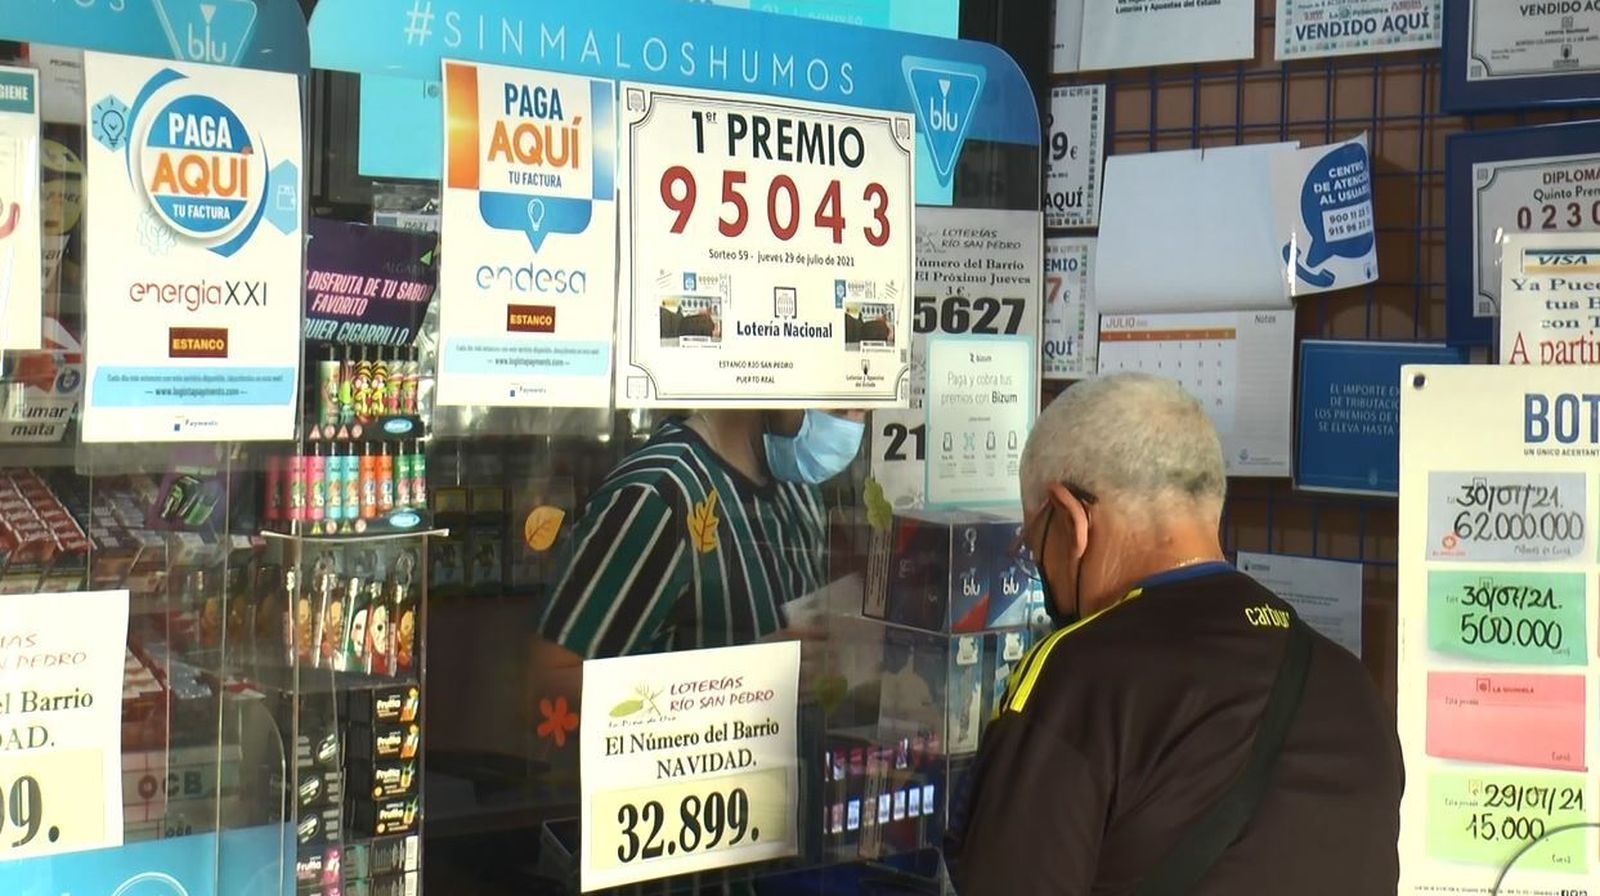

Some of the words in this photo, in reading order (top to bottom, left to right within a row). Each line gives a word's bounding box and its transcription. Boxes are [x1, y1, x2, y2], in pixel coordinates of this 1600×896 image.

[1520, 1, 1581, 16] VENDIDO
[1296, 16, 1377, 41] VENDIDO
[1382, 7, 1430, 34] AQUÍ
[188, 22, 227, 62] blu
[404, 0, 855, 96] #SINMALOSHUMOS
[505, 83, 563, 121] PAGA
[930, 92, 958, 132] blu
[168, 112, 234, 150] PAGA
[488, 117, 582, 170] AQUÍ
[727, 113, 866, 169] PREMIO
[151, 146, 253, 199] AQUÍ
[509, 171, 522, 186] TU
[524, 173, 562, 189] FACTURA
[1313, 182, 1331, 194] DE
[1533, 188, 1572, 203] Quinto
[1045, 187, 1083, 212] AQUÍ
[1320, 194, 1336, 207] AL
[173, 203, 187, 219] TU
[189, 204, 231, 221] FACTURA
[1329, 212, 1349, 224] 900
[942, 228, 998, 239] LOTERÍAS
[941, 239, 960, 249] RÍO
[963, 240, 983, 249] SAN
[986, 240, 1021, 250] PEDRO
[709, 248, 736, 261] Sorteo
[738, 250, 750, 262] 59
[757, 252, 784, 267] jueves
[785, 253, 797, 265] 29
[797, 254, 806, 265] de
[807, 253, 825, 268] julio
[826, 255, 836, 266] de
[837, 256, 855, 267] 2021
[915, 257, 960, 269] úmero
[963, 258, 982, 269] del
[986, 258, 1025, 270] Barrio
[1538, 257, 1588, 266] VISA
[307, 270, 364, 296] DISFRUTA
[363, 278, 381, 298] DE
[381, 279, 398, 299] TU
[476, 263, 587, 295] endesa
[933, 272, 987, 283] Próximo
[990, 273, 1031, 286] Jueves
[1511, 278, 1540, 291] Ya
[311, 293, 369, 317] FAVORITO
[1545, 299, 1580, 310] tus
[510, 313, 553, 328] ESTANCO
[914, 296, 1026, 335] 5627
[1254, 314, 1277, 325] Notas
[1541, 319, 1580, 329] con
[337, 321, 410, 345] CIGARRILLO
[737, 320, 779, 340] Lotería
[783, 321, 833, 340] Nacional
[172, 338, 226, 352] ESTANCO
[1509, 331, 1531, 365] A
[759, 375, 776, 384] REAL
[991, 390, 1018, 404] Bizum
[1330, 384, 1341, 395] EL
[1343, 385, 1385, 397] IMPORTE
[1330, 396, 1342, 408] DE
[1315, 407, 1331, 419] LOS
[1334, 409, 1377, 421] PREMIOS
[1379, 411, 1393, 422] DE
[11, 423, 55, 437] mata
[1319, 421, 1329, 433] SE
[1331, 423, 1360, 433] ELEVA
[1363, 424, 1395, 436] HASTA
[1524, 449, 1535, 458] UN
[963, 577, 980, 596] blu
[1002, 576, 1019, 595] blu
[1461, 613, 1562, 650] 500.000
[17, 650, 87, 670] PEDRO
[669, 677, 744, 697] LOTERÍAS
[21, 687, 93, 713] Barrio
[669, 697, 695, 713] RÍO
[699, 696, 725, 710] SAN
[729, 689, 774, 706] PEDRO
[604, 737, 625, 757] El
[630, 729, 699, 755] Número
[703, 723, 728, 745] del
[732, 716, 780, 743] Barrio
[656, 747, 758, 780] NAVIDAD.
[138, 770, 203, 801] OCB
[616, 787, 759, 864] 32.899.
